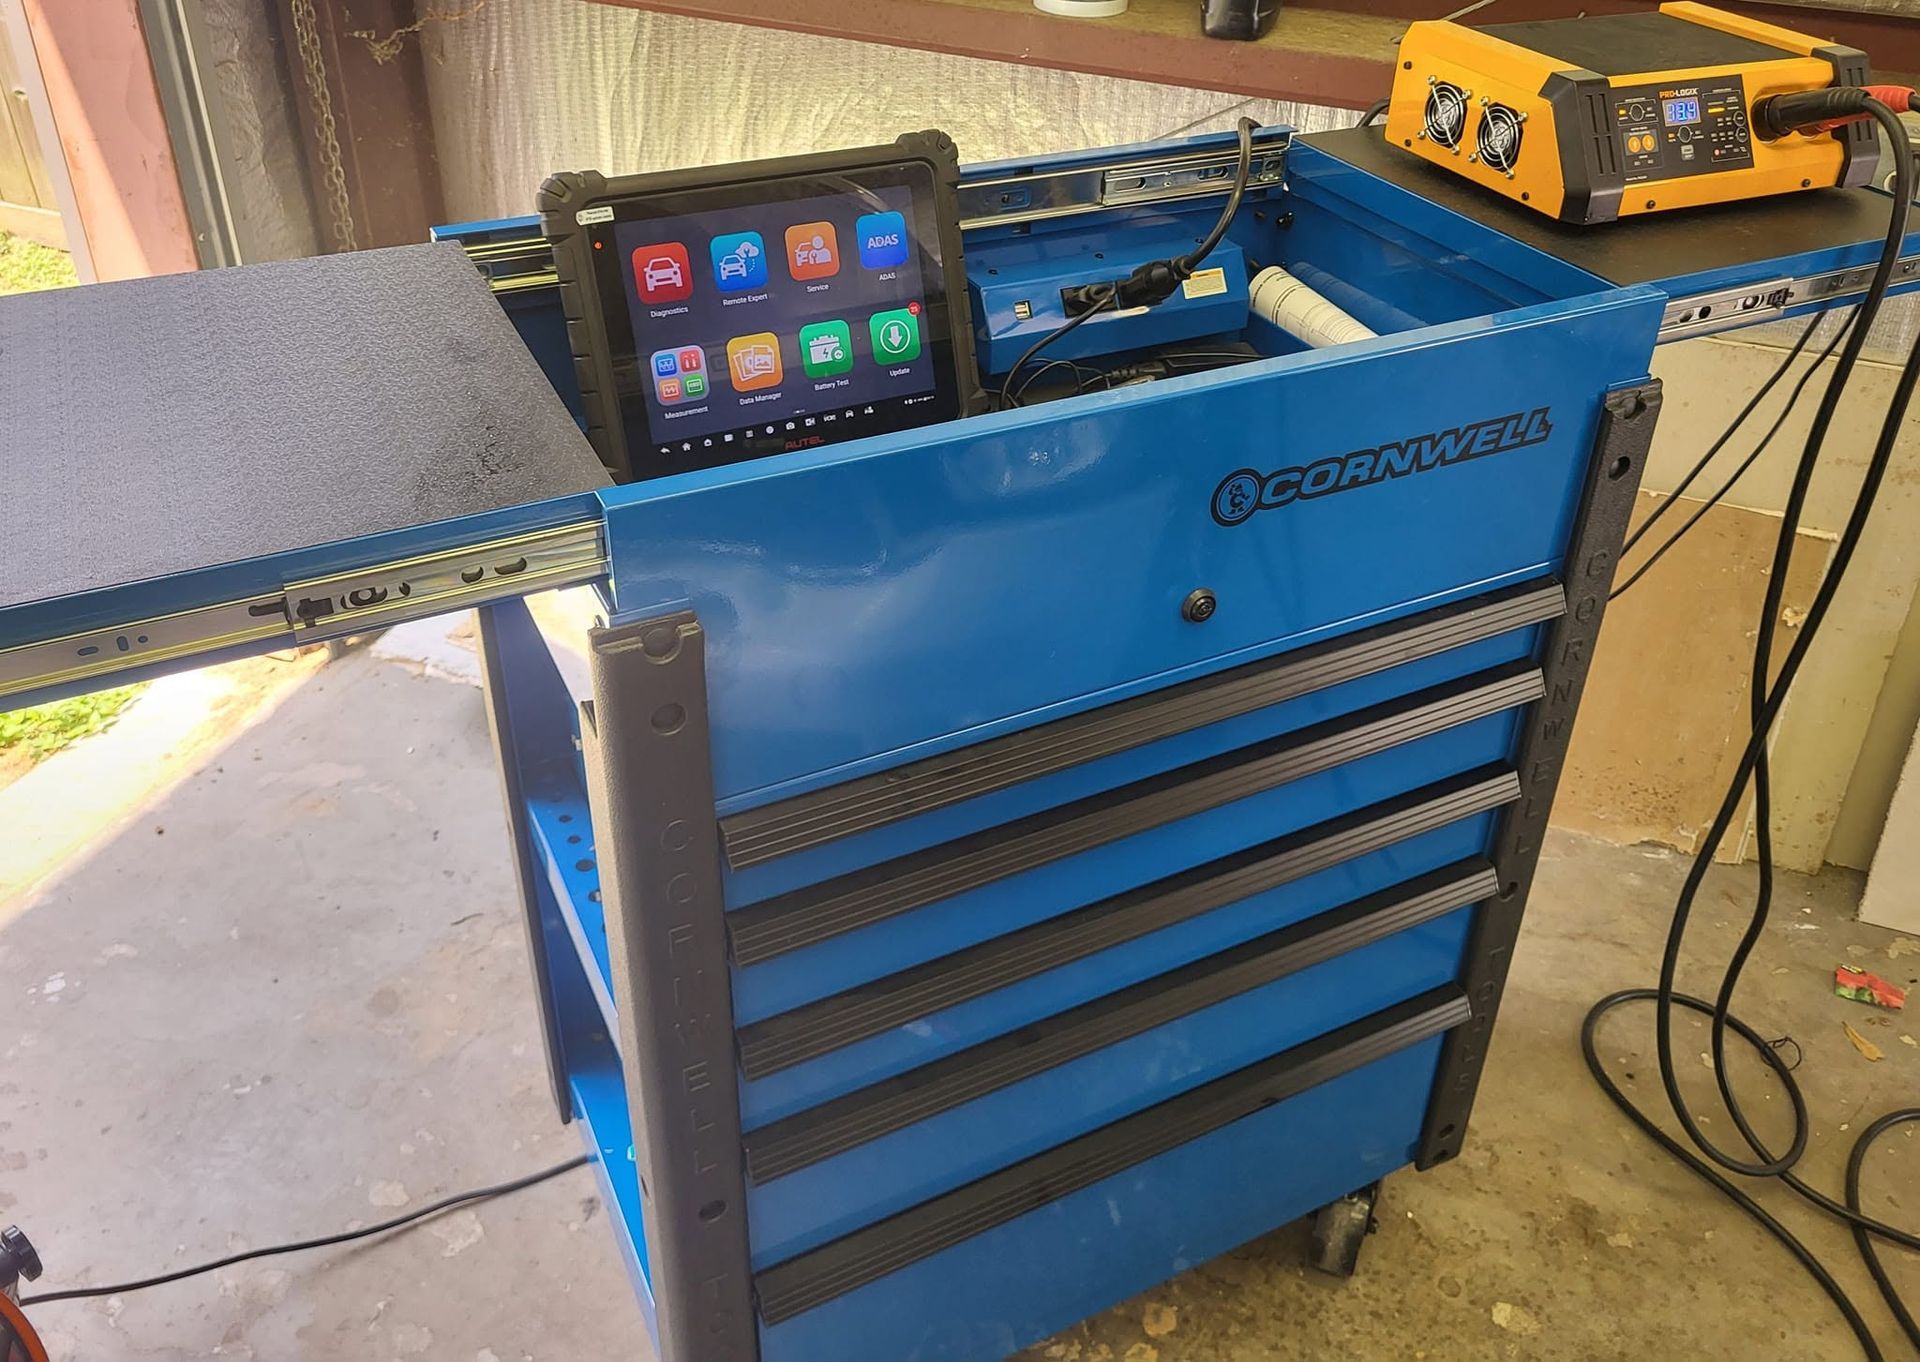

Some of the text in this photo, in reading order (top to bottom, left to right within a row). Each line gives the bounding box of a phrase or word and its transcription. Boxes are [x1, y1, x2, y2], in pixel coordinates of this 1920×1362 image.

[867, 233, 899, 249] ADAS
[878, 272, 897, 281] ADAS
[806, 283, 830, 293] Service
[722, 293, 768, 307] Remote Expert
[650, 305, 689, 318] Diagnostics
[889, 367, 911, 377] Update
[814, 379, 850, 391] Battery Test
[739, 391, 782, 406] Data Manager
[664, 405, 709, 420] Measurement
[784, 435, 826, 450] AUTEL
[1258, 405, 1554, 511] CORNWELL
[1513, 551, 1608, 856] CORNWELL
